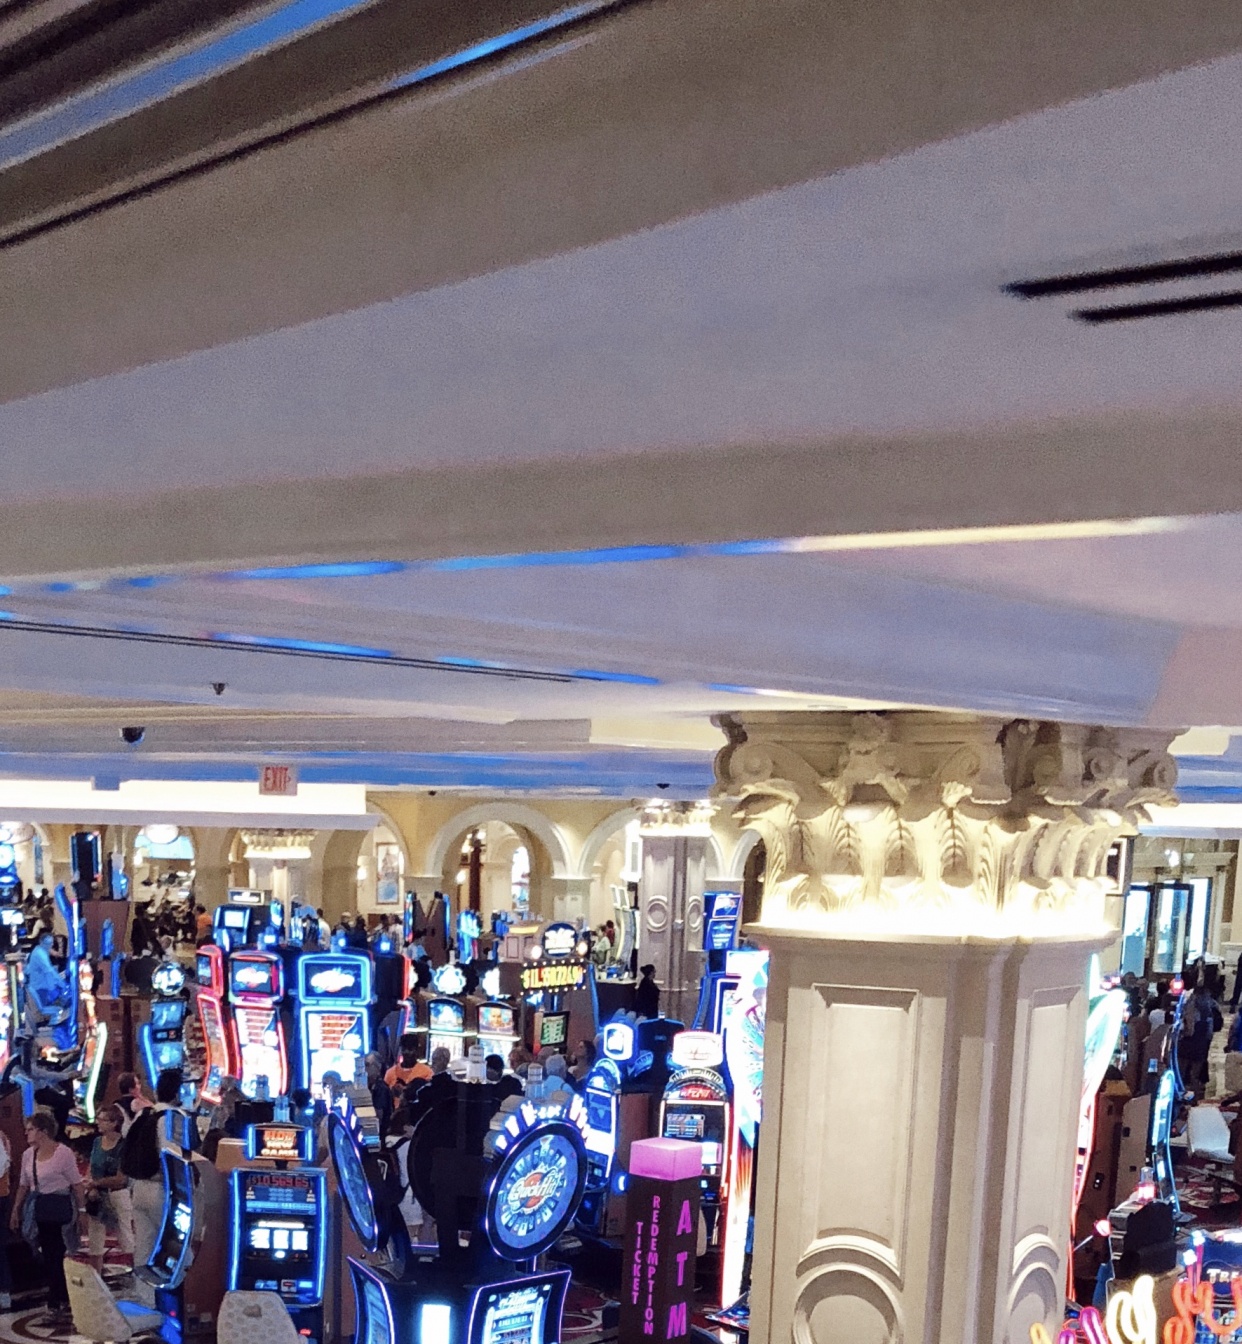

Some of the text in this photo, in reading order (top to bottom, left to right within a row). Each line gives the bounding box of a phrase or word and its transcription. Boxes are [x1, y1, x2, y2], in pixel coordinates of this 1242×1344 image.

[264, 766, 289, 792] EXIT
[632, 1221, 644, 1306] TICKET
[643, 1195, 661, 1335] REDEMPTION
[666, 1199, 692, 1340] ATM
